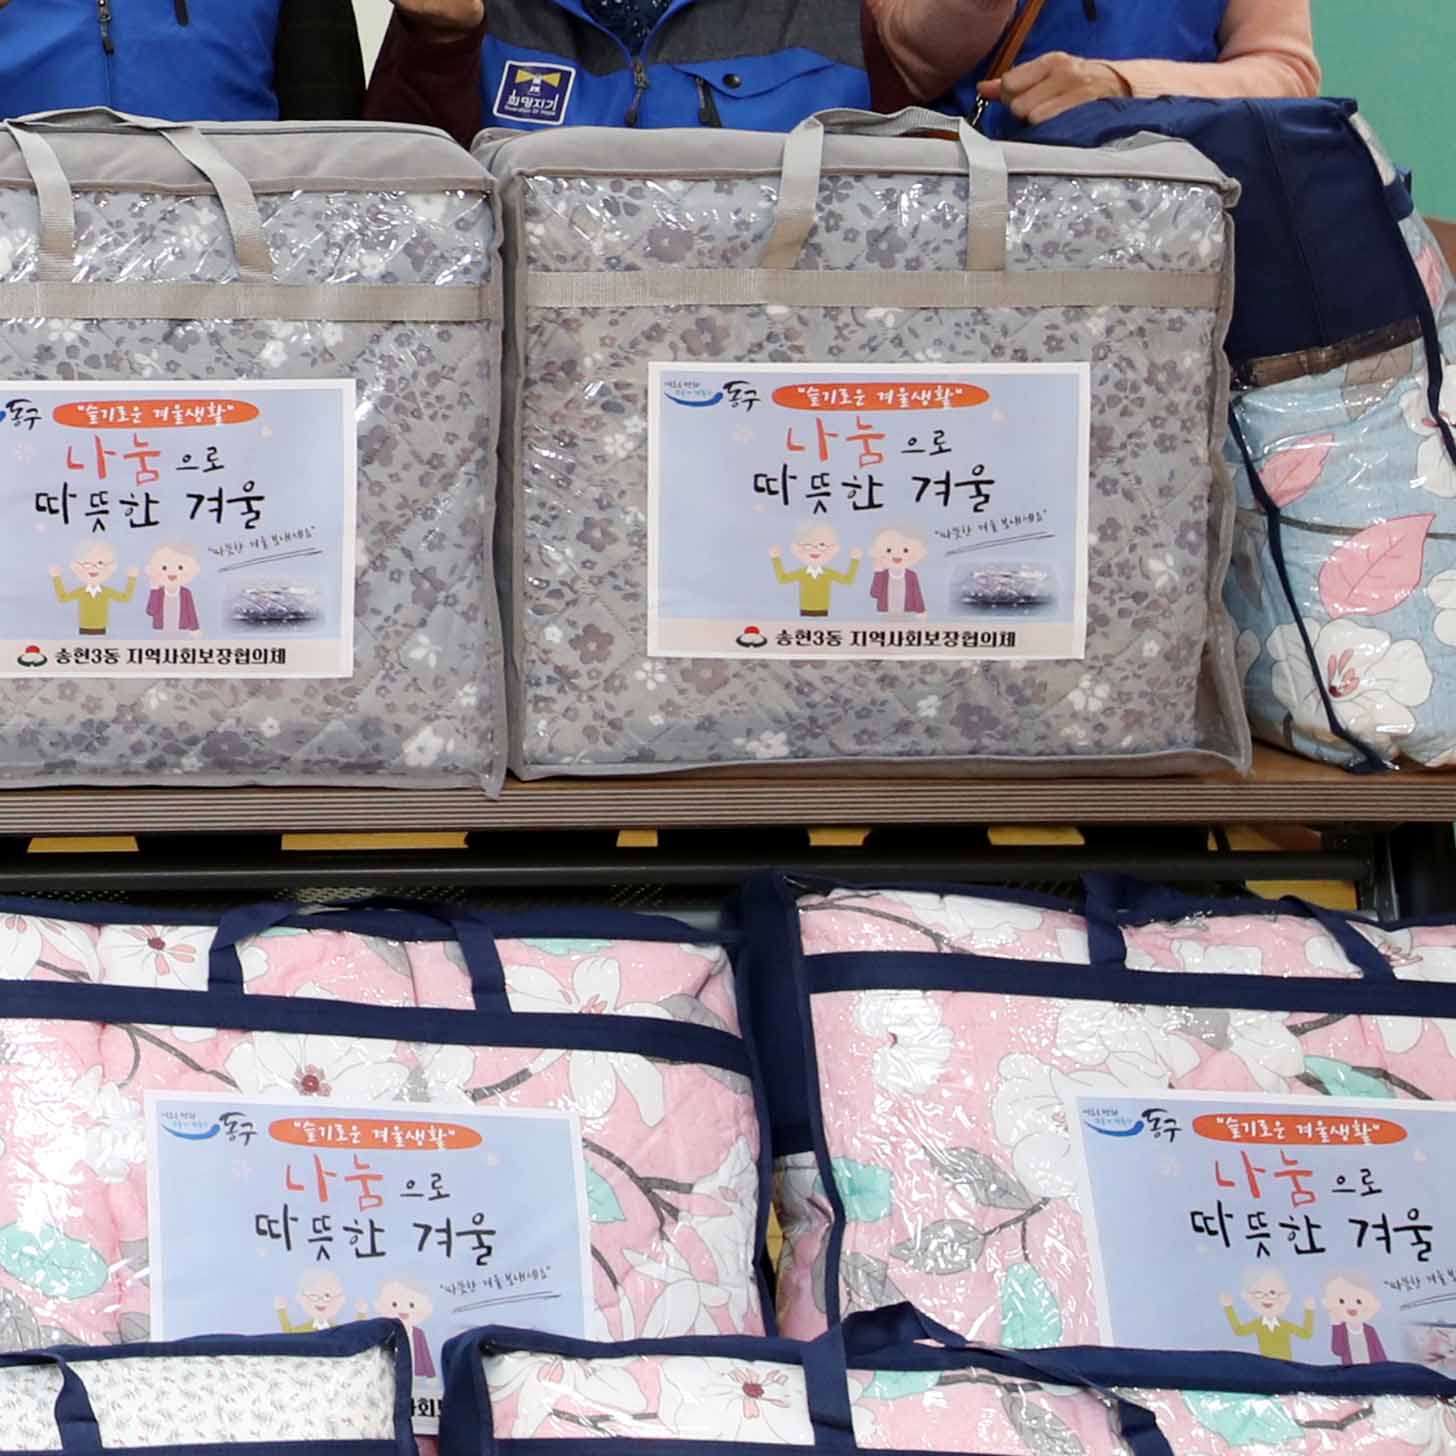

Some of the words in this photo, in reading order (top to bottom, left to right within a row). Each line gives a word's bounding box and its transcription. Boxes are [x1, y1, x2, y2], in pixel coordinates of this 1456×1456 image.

[722, 380, 761, 412] 동구
[5, 399, 42, 430] 동구
[754, 463, 884, 514] 따뜻한
[911, 463, 994, 512] 겨울
[35, 482, 160, 532] 따뜻한
[187, 480, 265, 529] 겨울
[56, 646, 120, 665] 송현3동
[127, 646, 286, 665] 지역사회보장협의체
[776, 629, 842, 646] 송현3동
[850, 630, 1015, 648] 지역사회보장협의체
[219, 1112, 257, 1145] 동구
[1142, 1108, 1183, 1143] 동구
[255, 1203, 386, 1261] 따뜻한
[412, 1212, 496, 1266] 겨울
[1191, 1200, 1326, 1259] 따뜻한
[1348, 1208, 1434, 1262] 겨울
